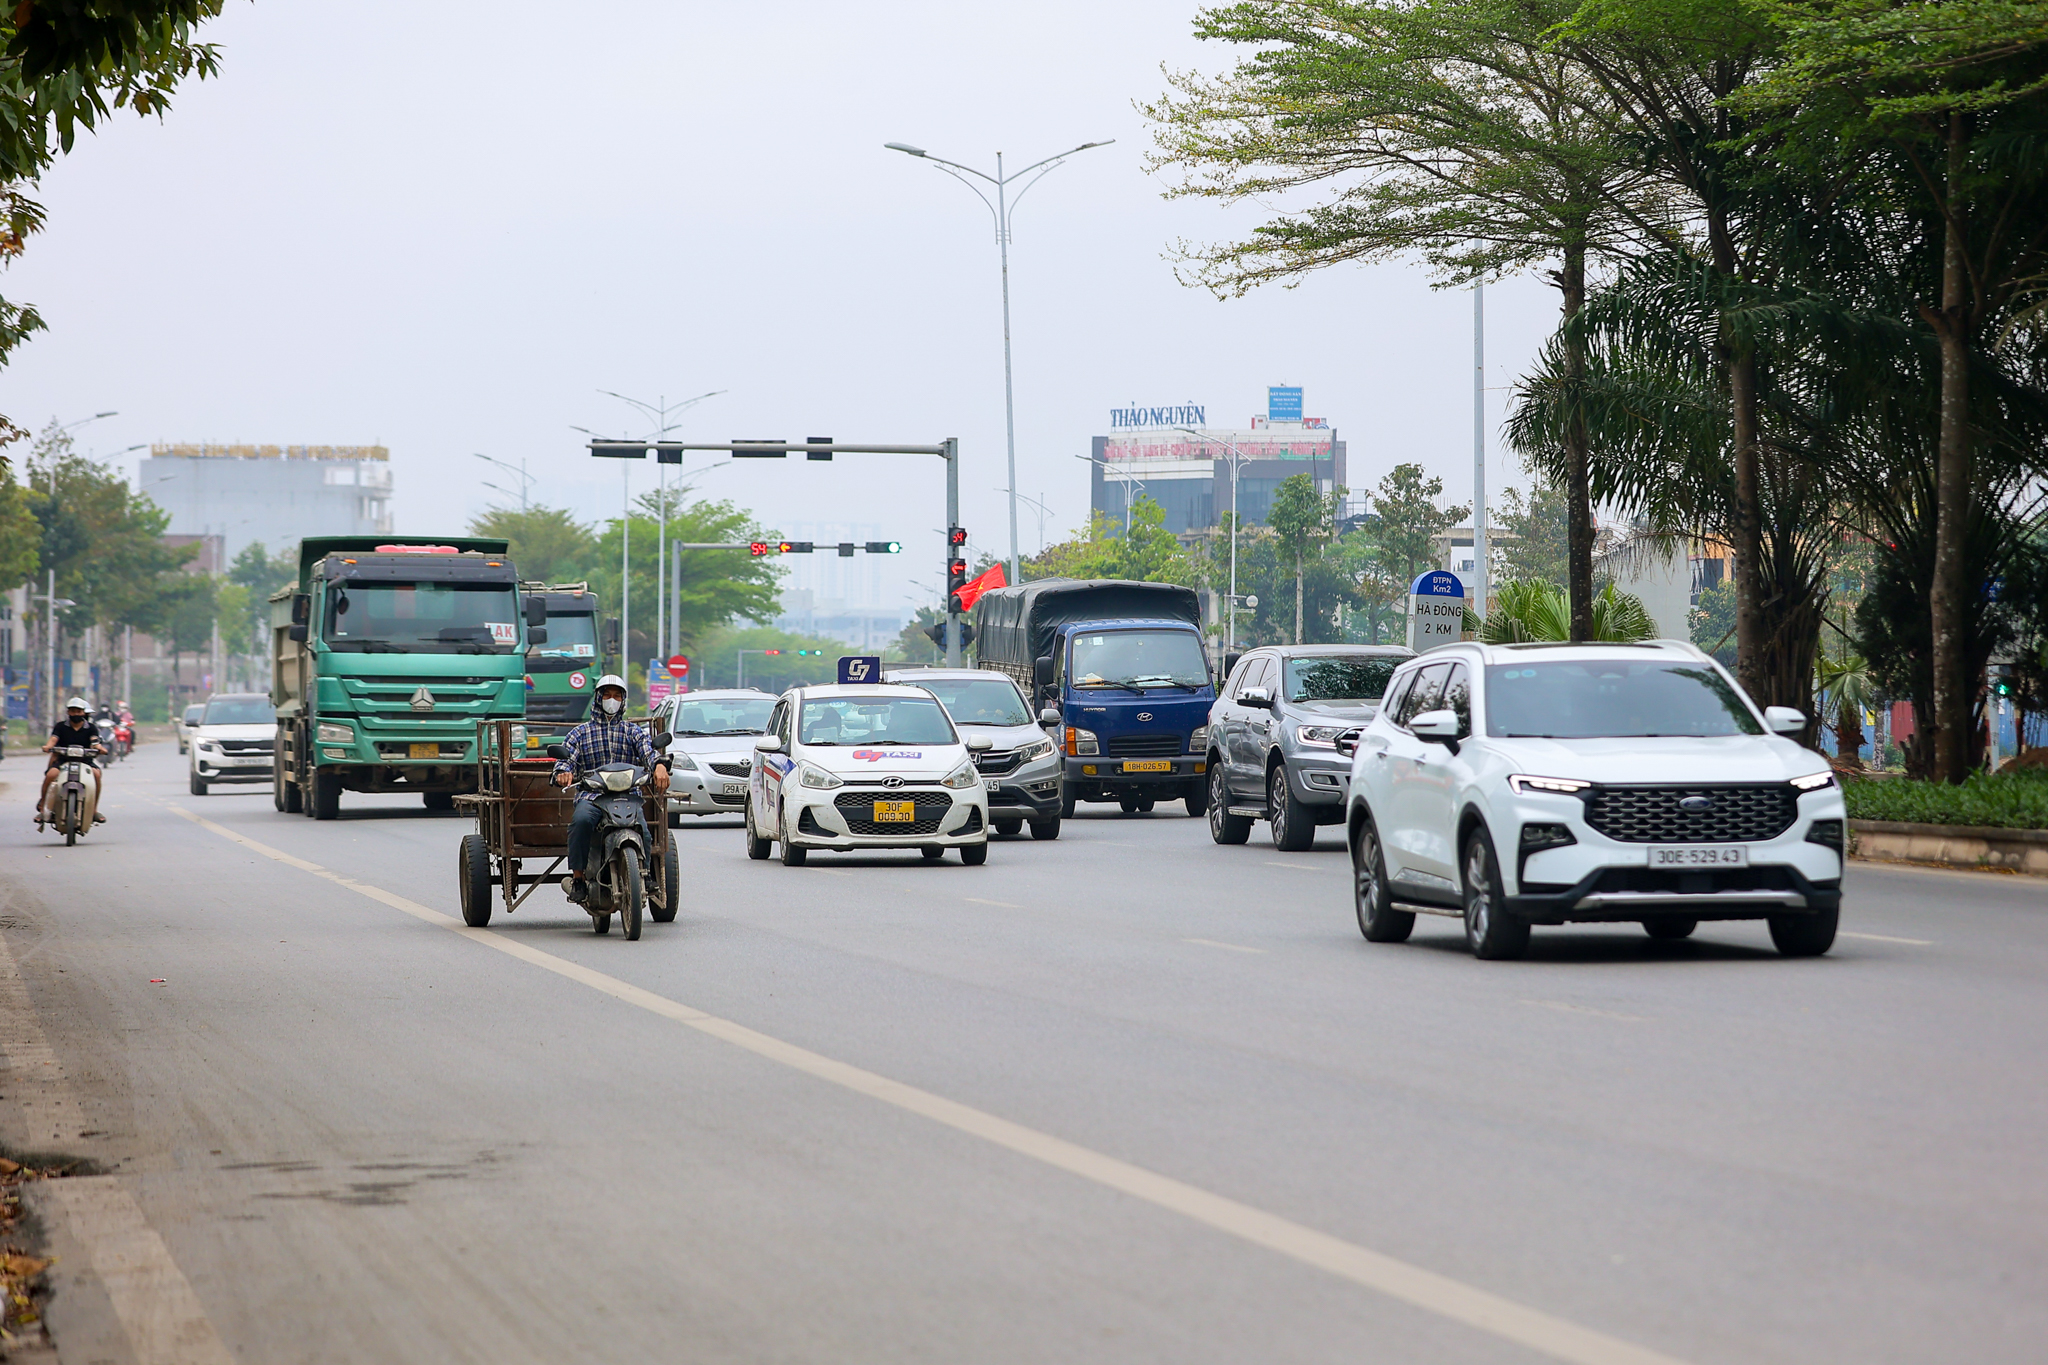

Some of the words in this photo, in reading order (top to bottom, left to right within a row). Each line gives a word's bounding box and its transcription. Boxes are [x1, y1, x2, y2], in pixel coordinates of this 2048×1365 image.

[1110, 401, 1148, 427] THẢO
[1150, 400, 1205, 425] NGUYÊN
[751, 542, 767, 556] 54
[1433, 576, 1452, 584] ĐTPN
[1433, 585, 1451, 593] Km2
[1417, 602, 1431, 615] HÀ
[1433, 602, 1462, 617] ĐÔNG
[1425, 623, 1431, 634] 2
[1436, 624, 1452, 635] KM
[578, 646, 589, 655] BT
[849, 659, 870, 681] G7
[885, 802, 903, 811] 30F
[878, 812, 910, 821] 009.30
[1657, 849, 1739, 863] 30E-529.43
